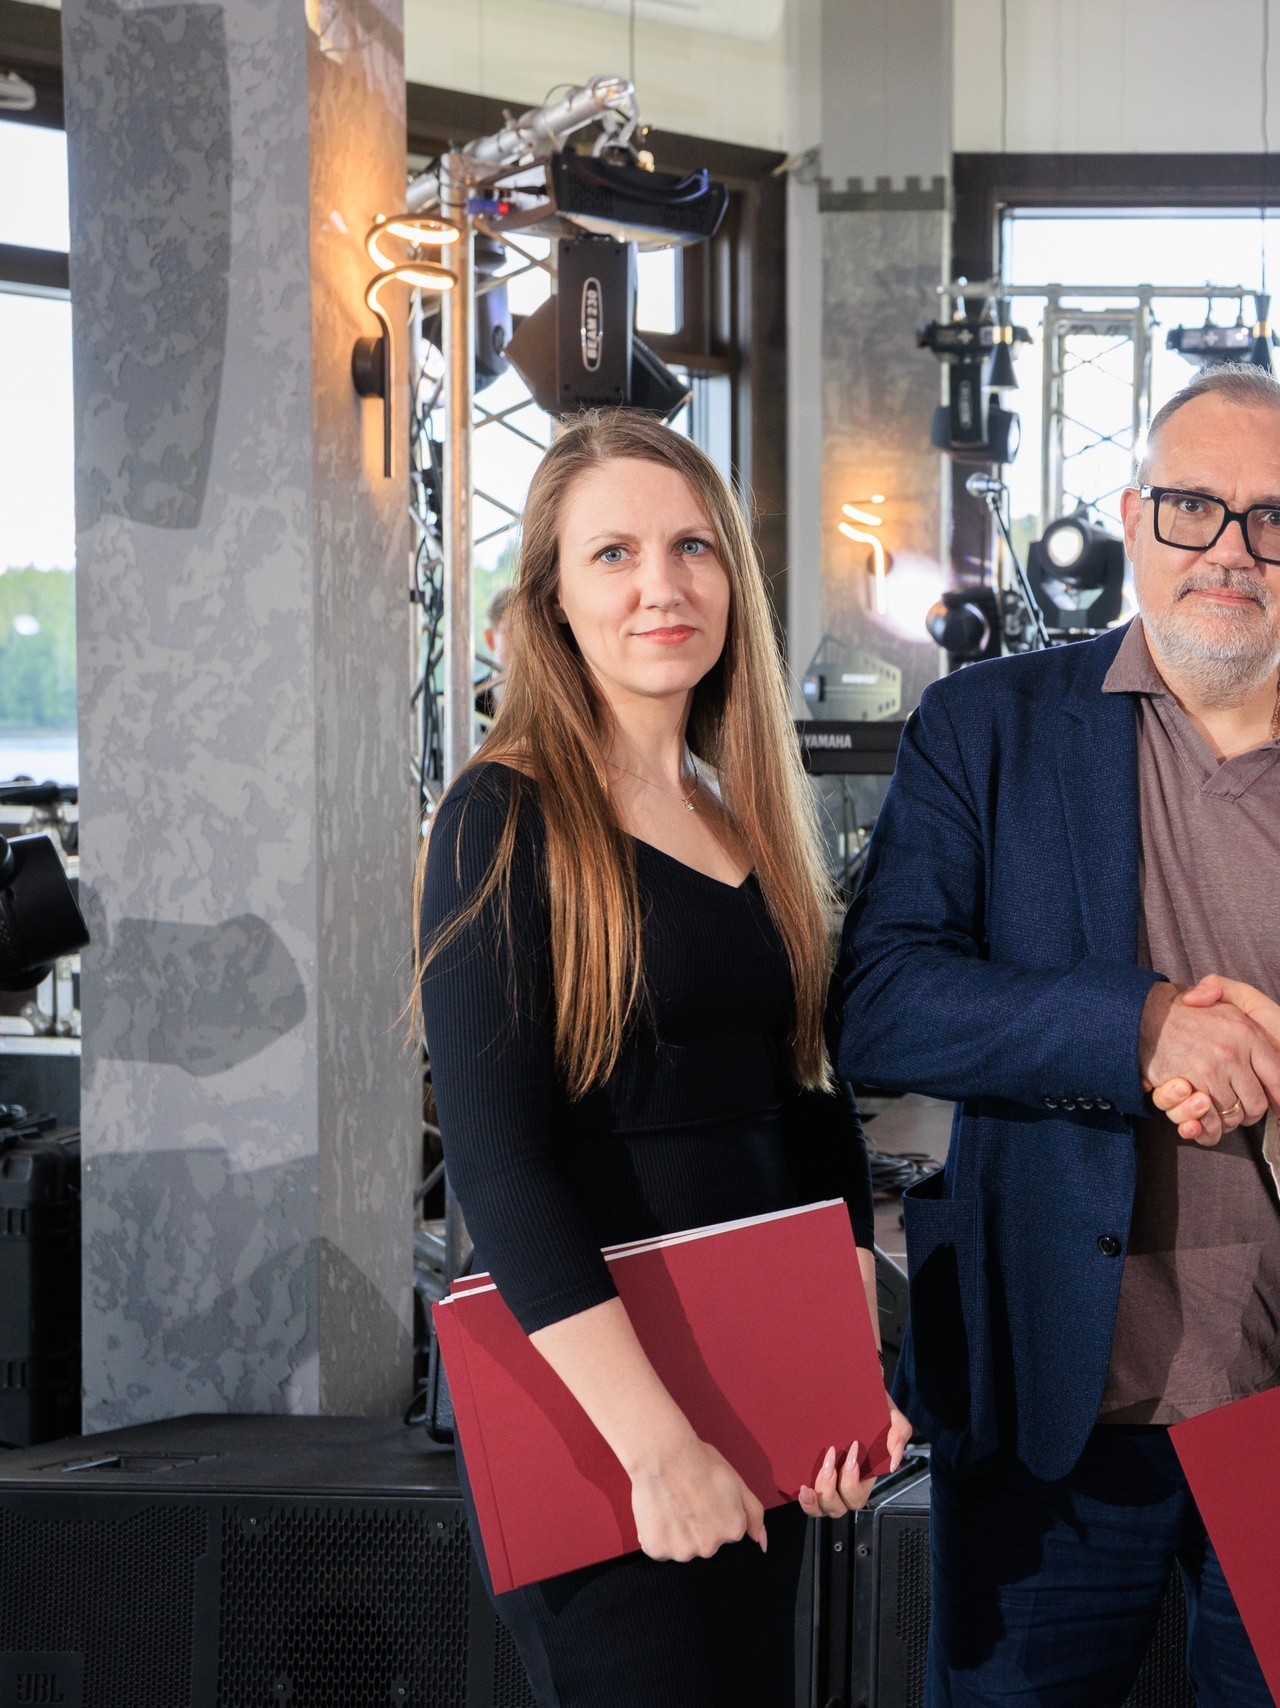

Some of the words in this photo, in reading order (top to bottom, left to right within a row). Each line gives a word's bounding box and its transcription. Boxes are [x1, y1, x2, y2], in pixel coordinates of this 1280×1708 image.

[587, 289, 598, 316] 230
[587, 317, 598, 359] BEAM
[803, 734, 852, 749] YAMAHA
[17, 1673, 65, 1703] JBL
